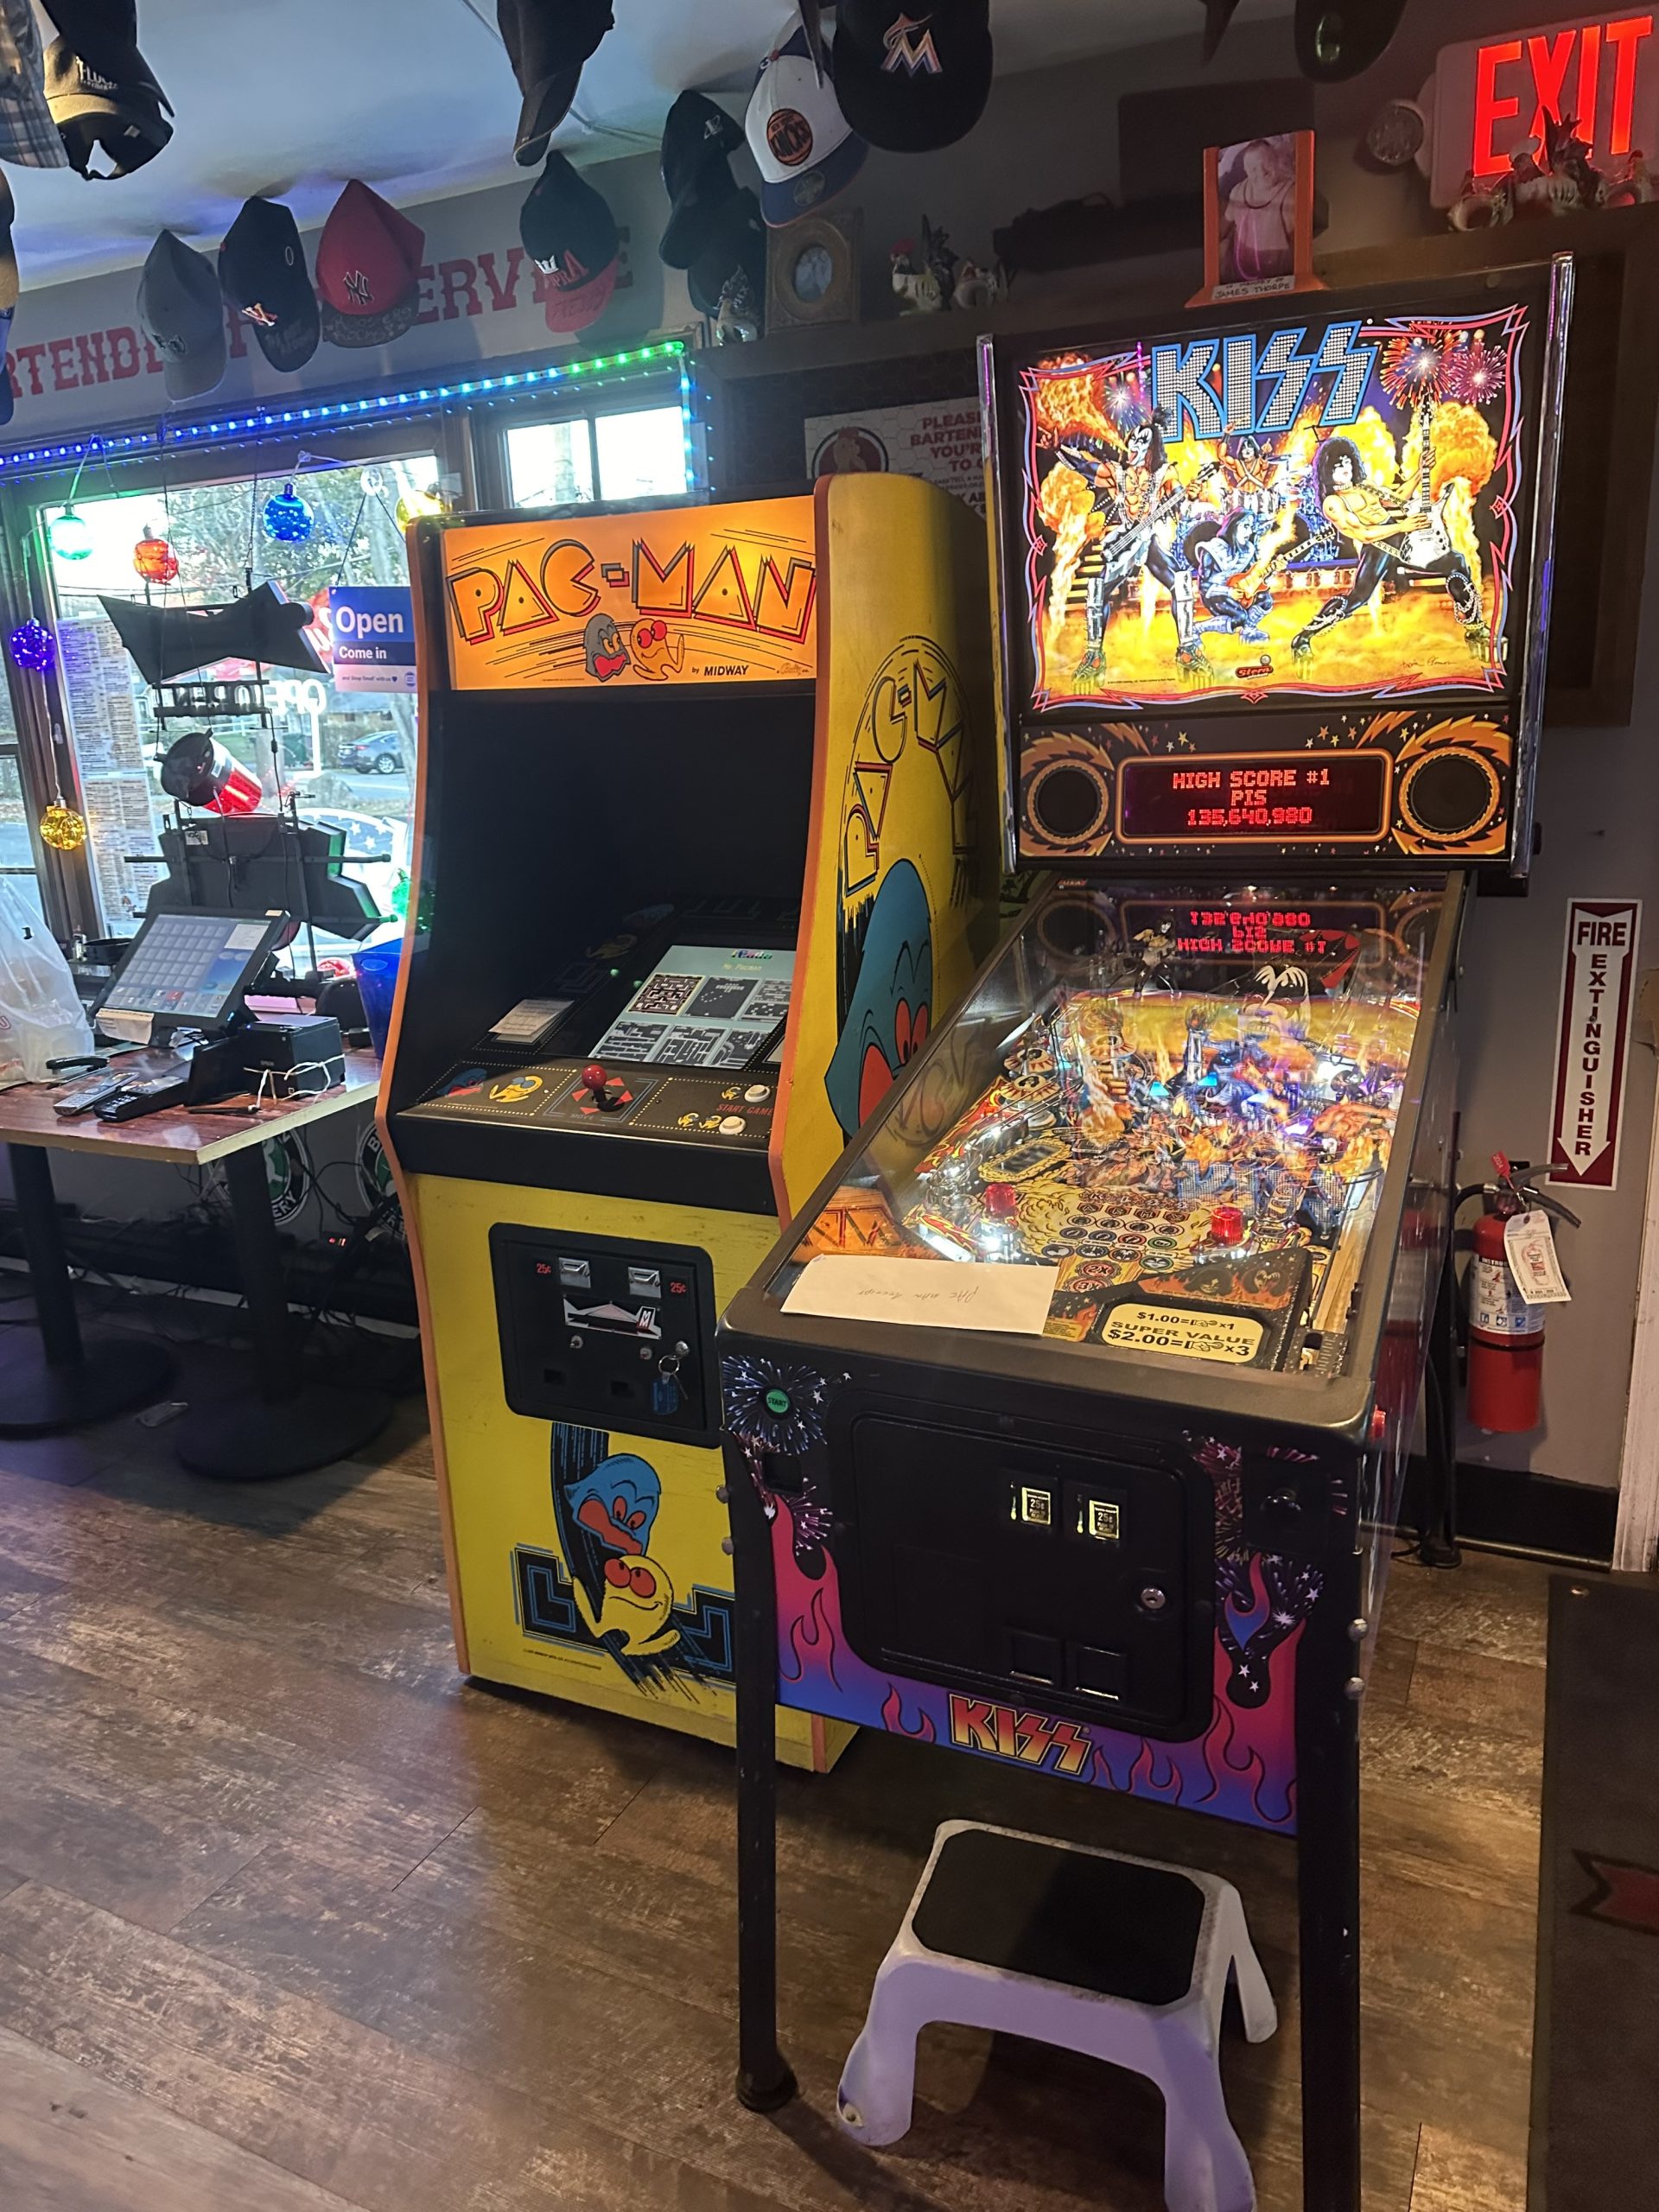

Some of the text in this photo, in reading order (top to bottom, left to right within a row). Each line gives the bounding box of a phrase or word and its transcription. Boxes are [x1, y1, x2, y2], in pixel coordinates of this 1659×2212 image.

[1474, 16, 1653, 176] EXIT
[1214, 283, 1291, 299] JAMES THORPE
[1151, 320, 1378, 444] KISS
[948, 458, 972, 473] TO
[446, 538, 817, 646] PAC-MAN
[335, 606, 404, 639] Open
[339, 645, 388, 659] Come in
[703, 664, 750, 677] MIDWAY
[1173, 768, 1330, 789] HIGH SCORE #1
[1230, 789, 1268, 806] PIS
[1187, 806, 1313, 827] 135,640,980
[1577, 921, 1627, 946] FIRE
[1574, 953, 1608, 1156] EXTINGUISHER
[570, 1112, 595, 1121] MOVE
[716, 1103, 773, 1116] START GAME
[536, 1262, 552, 1274] 25¢
[670, 1281, 687, 1294] 25¢
[1111, 1320, 1255, 1345] SUPER VALUE
[1219, 1322, 1235, 1331] x1
[1225, 1344, 1250, 1357] x3
[767, 1396, 787, 1408] START
[949, 1694, 1092, 1776] KISS
